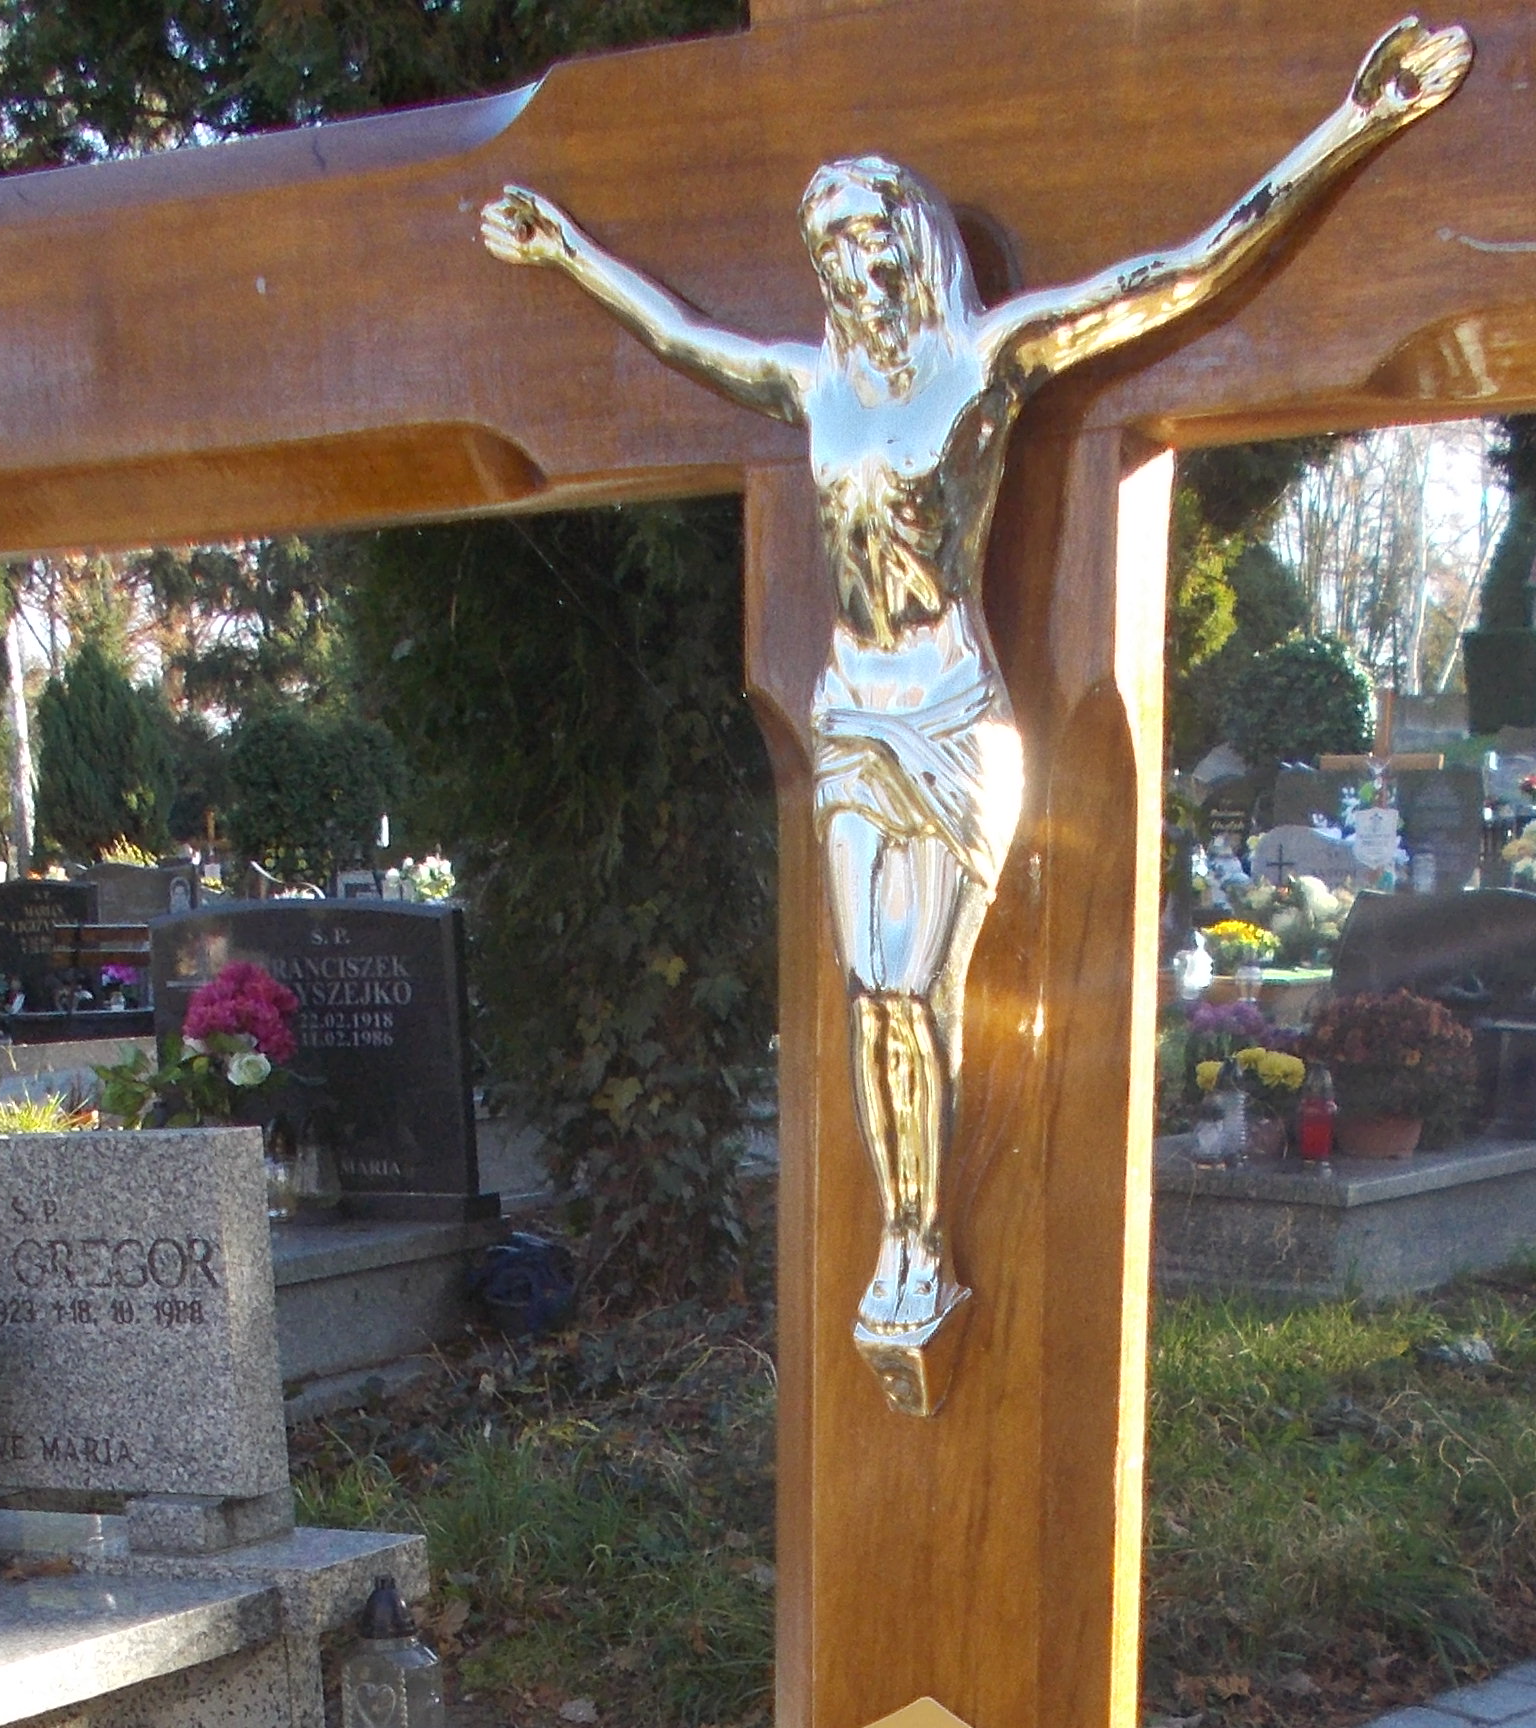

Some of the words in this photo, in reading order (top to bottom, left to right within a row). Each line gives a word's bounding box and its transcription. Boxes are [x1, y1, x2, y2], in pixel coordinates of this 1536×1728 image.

[271, 956, 410, 979] RANCISZEK
[296, 980, 413, 1006] YSZEJKO
[13, 1237, 221, 1290] GREGOR
[38, 1434, 139, 1468] MARIA
